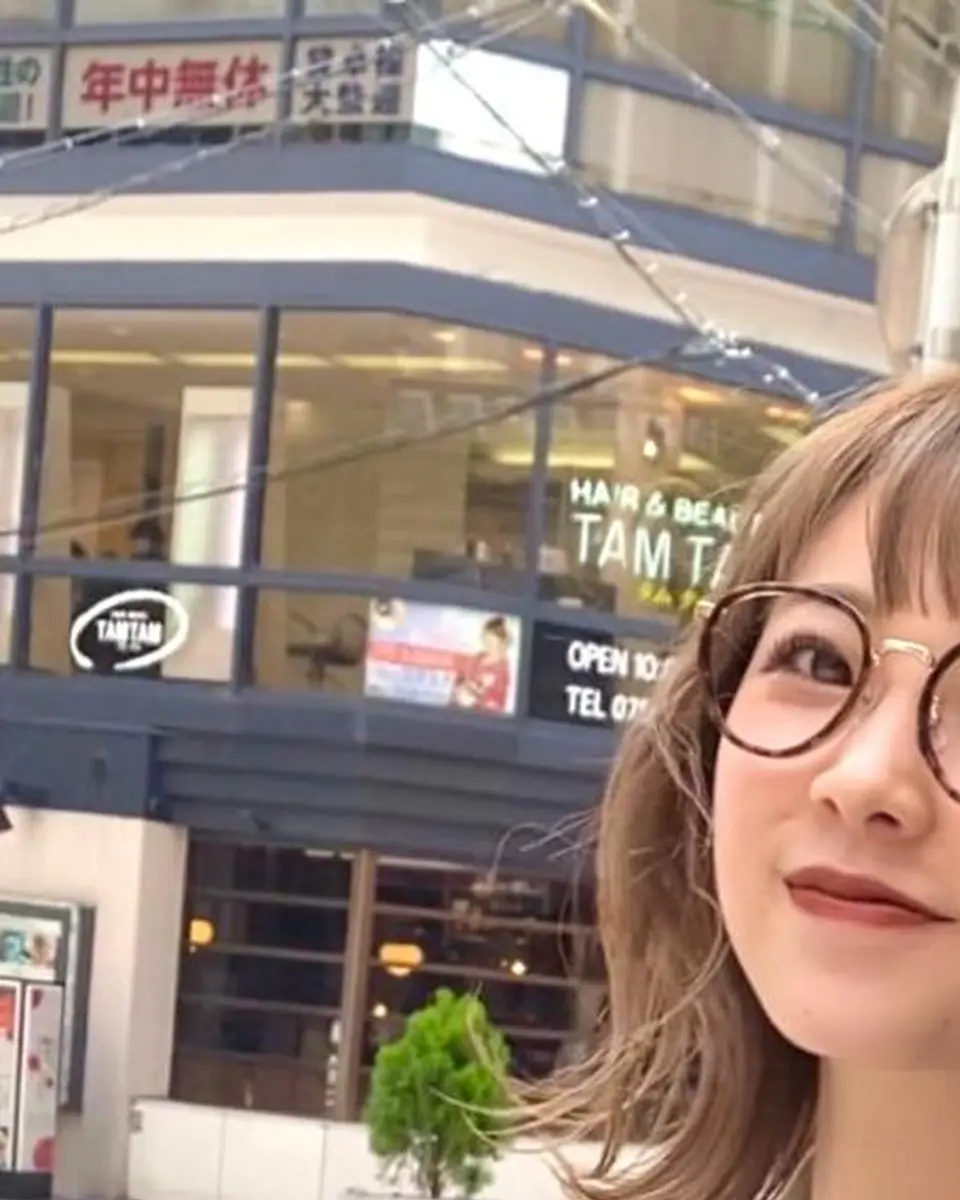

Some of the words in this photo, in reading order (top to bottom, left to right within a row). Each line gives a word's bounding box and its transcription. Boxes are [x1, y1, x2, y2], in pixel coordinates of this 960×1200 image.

[80, 55, 271, 116] 年中無休
[570, 477, 641, 513] HAIR
[645, 490, 667, 518] &
[571, 513, 672, 583] TAM
[567, 640, 629, 677] OPEN
[564, 684, 607, 719] TEL
